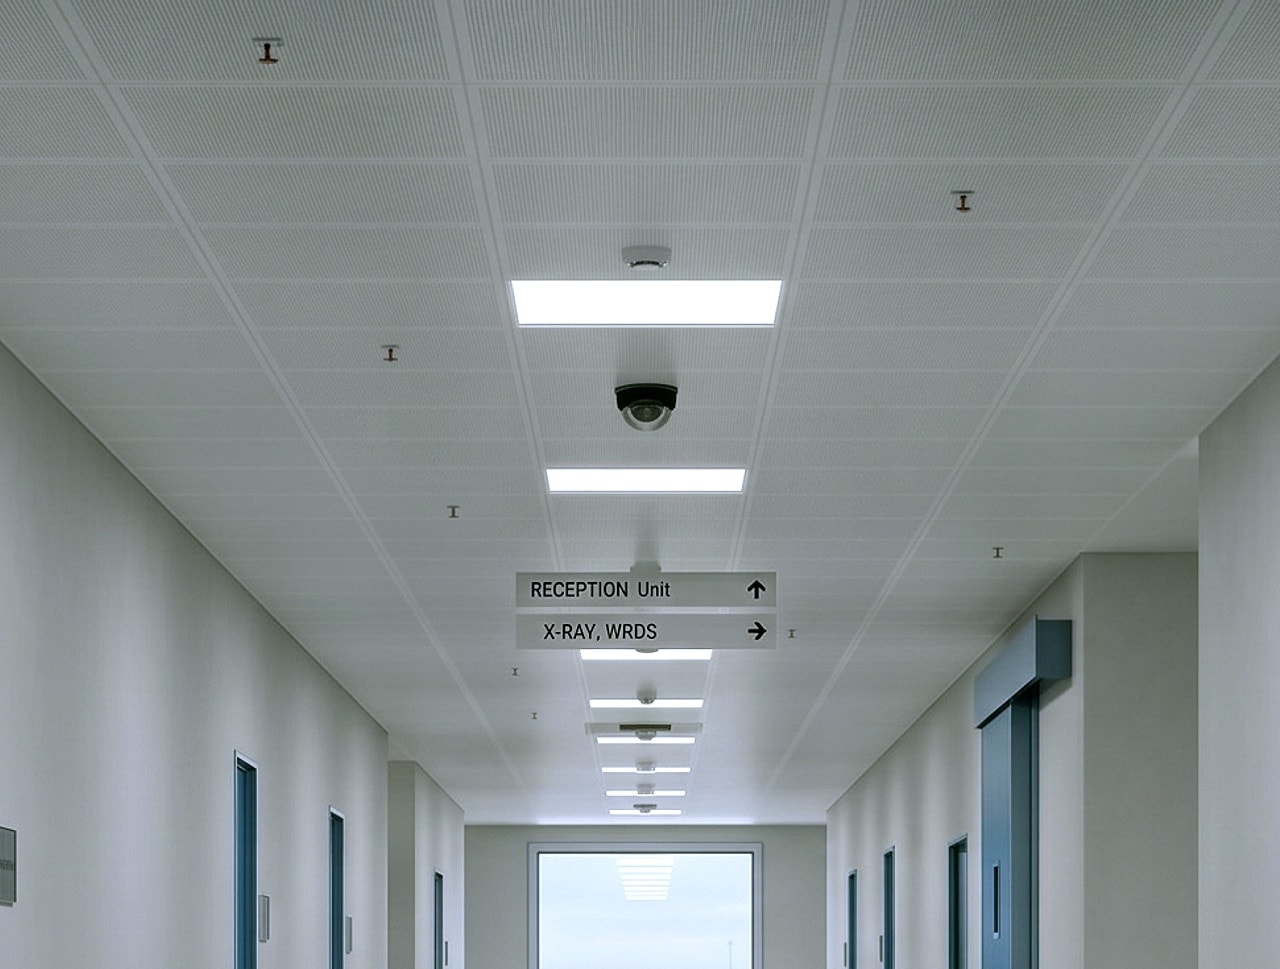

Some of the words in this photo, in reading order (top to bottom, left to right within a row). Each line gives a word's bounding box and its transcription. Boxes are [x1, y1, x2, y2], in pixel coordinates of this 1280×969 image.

[531, 581, 628, 598] RECEPTION
[637, 581, 670, 598] Unit
[543, 623, 601, 642] X-RAY,
[606, 623, 657, 640] WRDS
